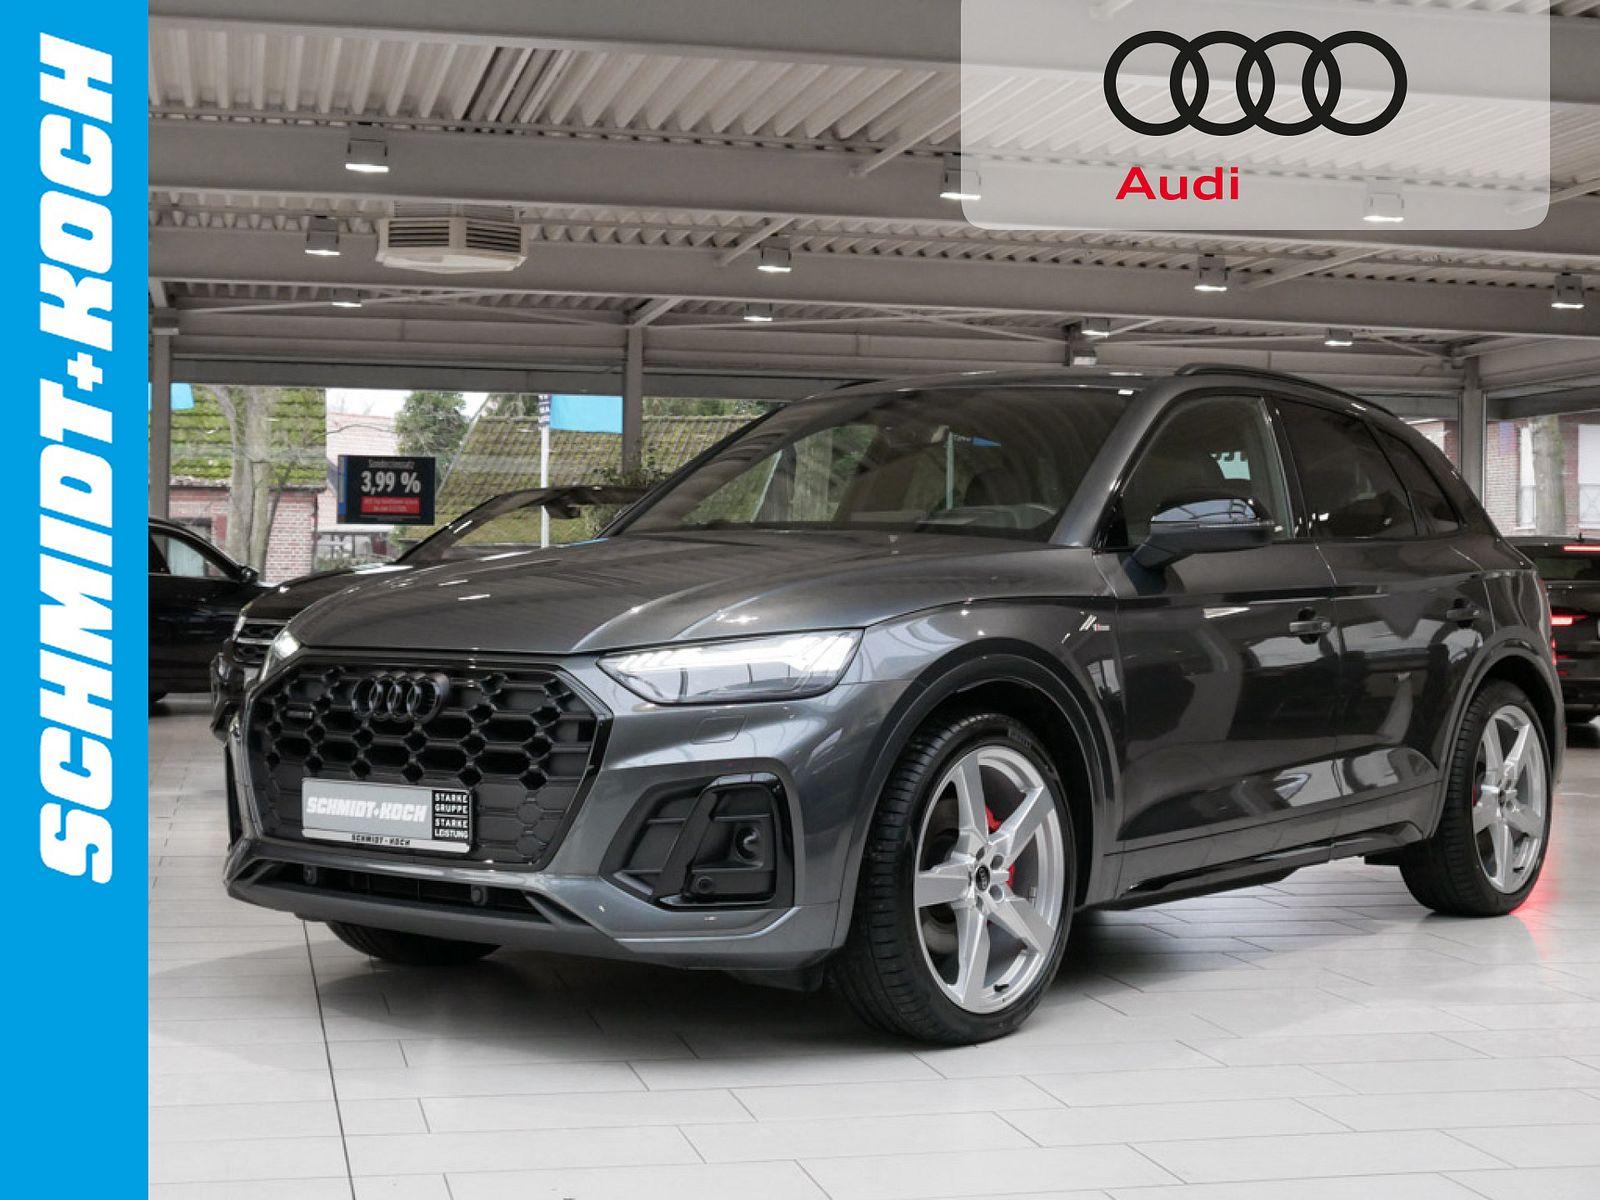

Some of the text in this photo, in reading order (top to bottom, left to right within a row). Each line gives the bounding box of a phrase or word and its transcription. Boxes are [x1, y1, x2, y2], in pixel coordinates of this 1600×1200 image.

[360, 470, 421, 495] 3,99 %
[434, 792, 468, 803] STARKE
[434, 803, 468, 814] GRUPPE
[434, 818, 468, 829] STARKE
[434, 829, 468, 840] LEISTUNG
